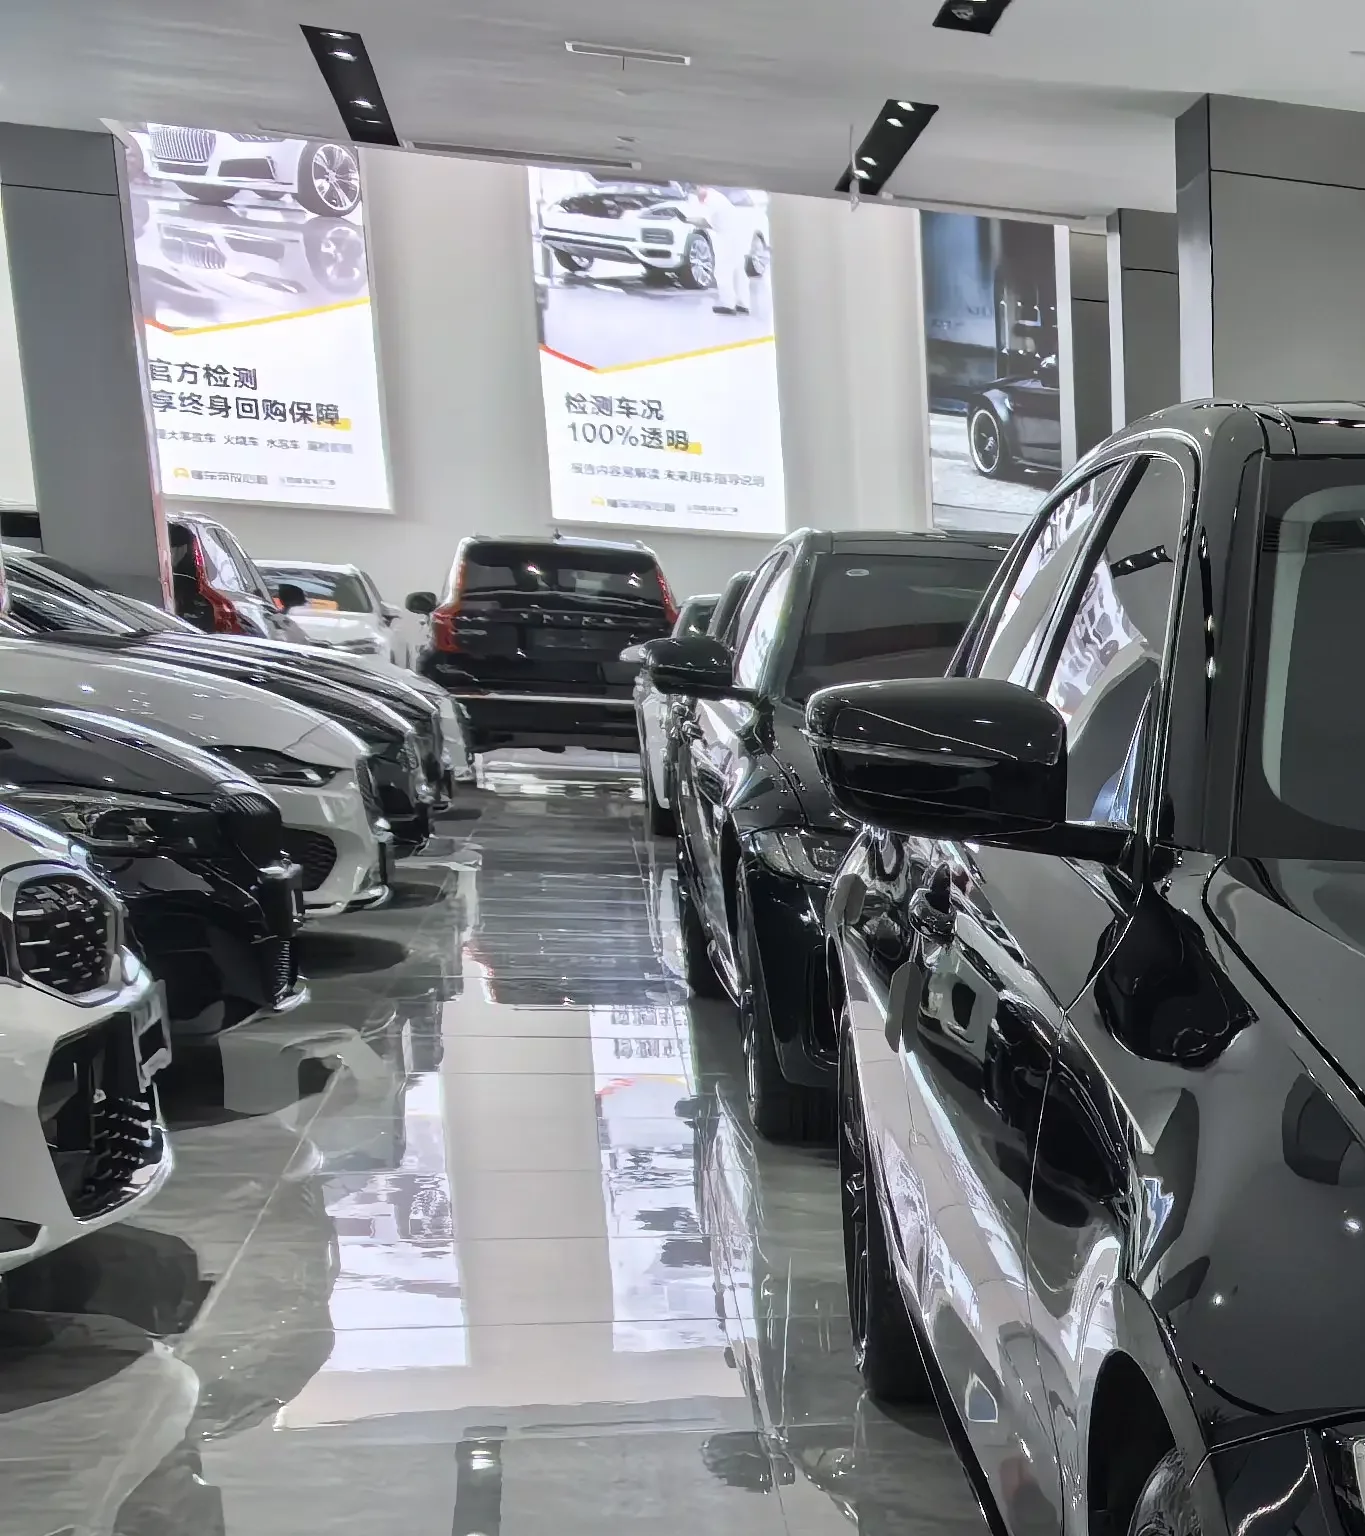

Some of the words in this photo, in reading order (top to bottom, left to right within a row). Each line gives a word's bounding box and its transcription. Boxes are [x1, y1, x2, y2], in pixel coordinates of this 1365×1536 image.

[149, 358, 258, 391] 官方检测
[151, 388, 342, 426] 享终身回购保障
[565, 392, 664, 421] 检测车况
[567, 421, 689, 451] 100%透明
